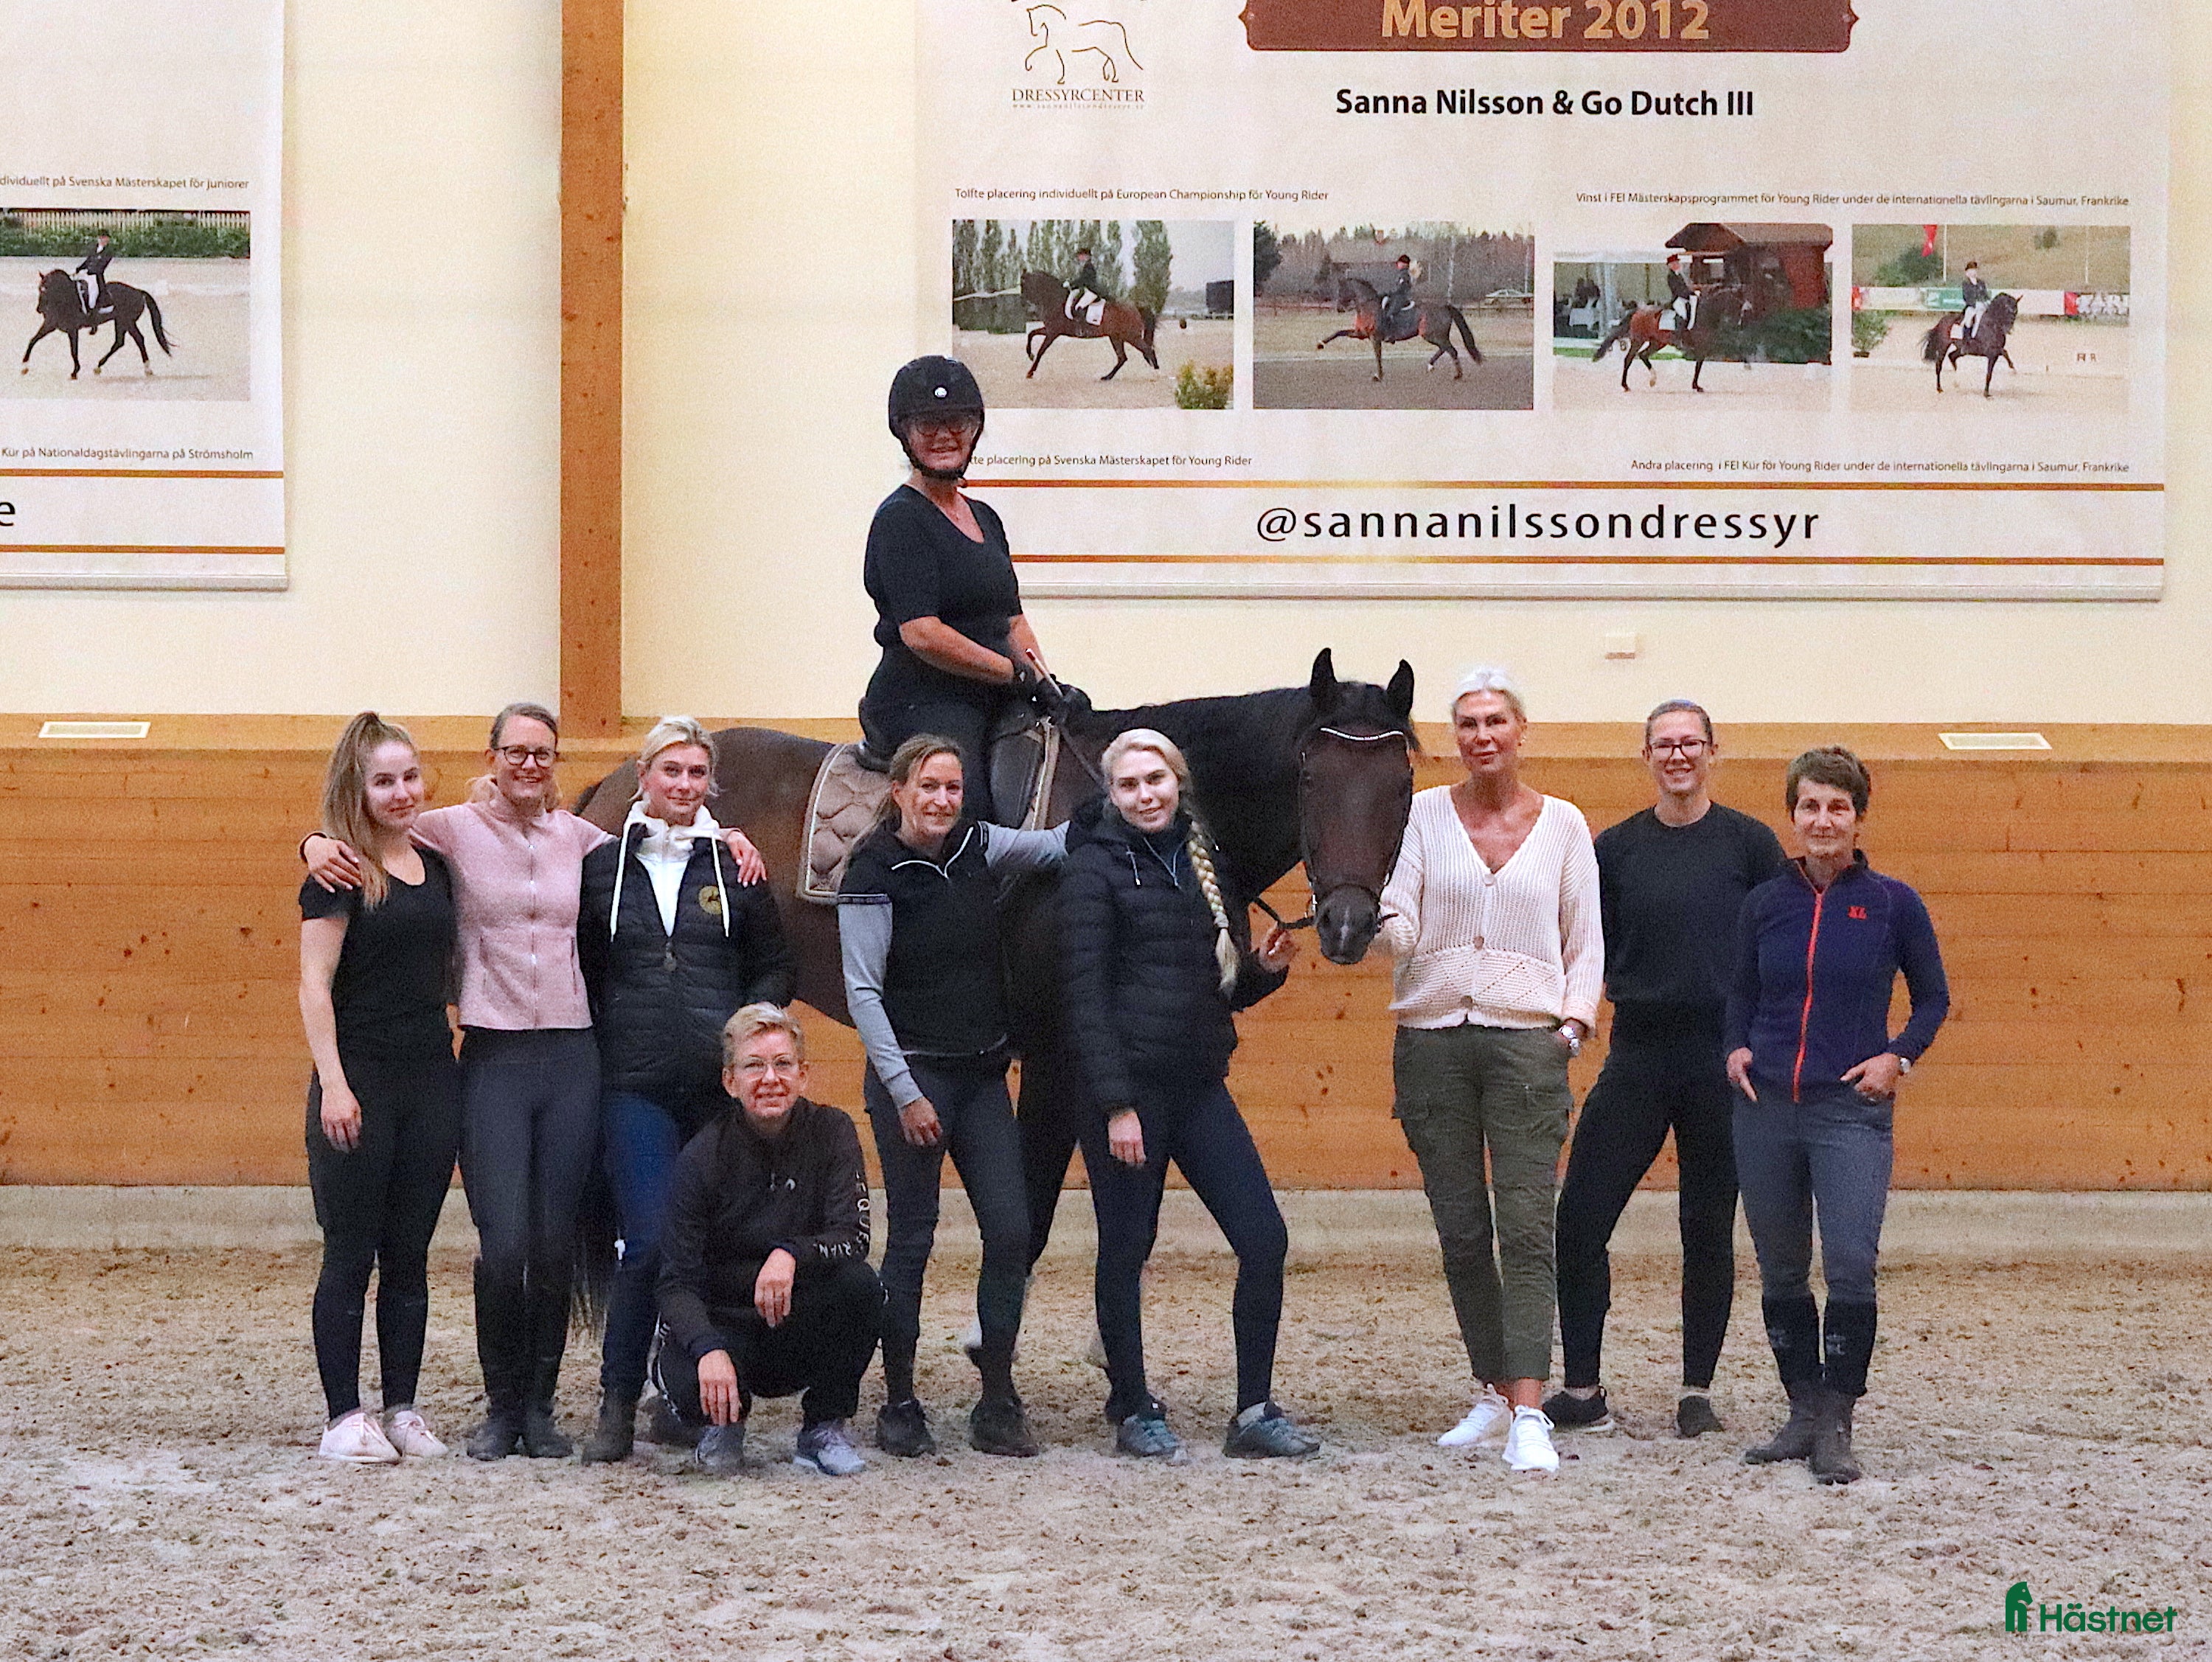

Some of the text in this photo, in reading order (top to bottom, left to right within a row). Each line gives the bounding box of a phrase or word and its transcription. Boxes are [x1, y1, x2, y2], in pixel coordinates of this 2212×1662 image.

[1381, 0, 1710, 41] Meriter 2012
[1012, 88, 1145, 102] DRESSYRCENTER
[1335, 88, 1753, 117] Sanna Nilsson & Go Dutch III
[52, 175, 66, 188] på
[69, 175, 112, 187] Svenska
[115, 176, 187, 190] Mästerskapet
[189, 176, 204, 189] för
[955, 188, 1329, 203] Tolfte placering individuellt på European Championship för Young Rider
[1576, 192, 1601, 203] Vinst
[1610, 192, 1626, 203] FEI
[1627, 192, 1759, 206] Mästerskapsprogrammet
[1760, 192, 1775, 204] för
[1777, 192, 1810, 206] Young
[1812, 193, 1840, 204] Rider
[1842, 194, 1874, 205] under
[1876, 193, 1891, 205] de
[1892, 194, 1968, 205] internationella
[1970, 194, 2028, 208] tävlingarna
[2036, 195, 2079, 207] Saumur,
[2081, 195, 2129, 206] Frankrike
[22, 447, 35, 459] på
[38, 448, 170, 461] Nationaldagstävlingarna
[172, 448, 186, 461] på
[188, 448, 254, 459] Strömsholm
[987, 453, 1036, 467] placering
[1038, 454, 1051, 467] på
[1054, 454, 1096, 465] Svenska
[1099, 454, 1169, 467] Mästerskapet
[1172, 454, 1187, 466] för
[1189, 454, 1222, 468] Young
[1224, 455, 1252, 466] Rider
[1630, 459, 1662, 470] Andra
[1664, 460, 1714, 473] placering
[1724, 460, 1739, 471] FEI
[1761, 459, 1776, 471] för
[1778, 460, 1812, 473] Young
[1814, 460, 1840, 471] Rider
[1843, 460, 1875, 472] under
[1877, 460, 1891, 472] de
[1893, 461, 1969, 472] internationella
[1970, 461, 2029, 474] tävlingarna
[2037, 462, 2080, 474] Saumur,
[2082, 461, 2129, 473] Frankrike
[1256, 504, 1820, 548] @sannanilssondressyr
